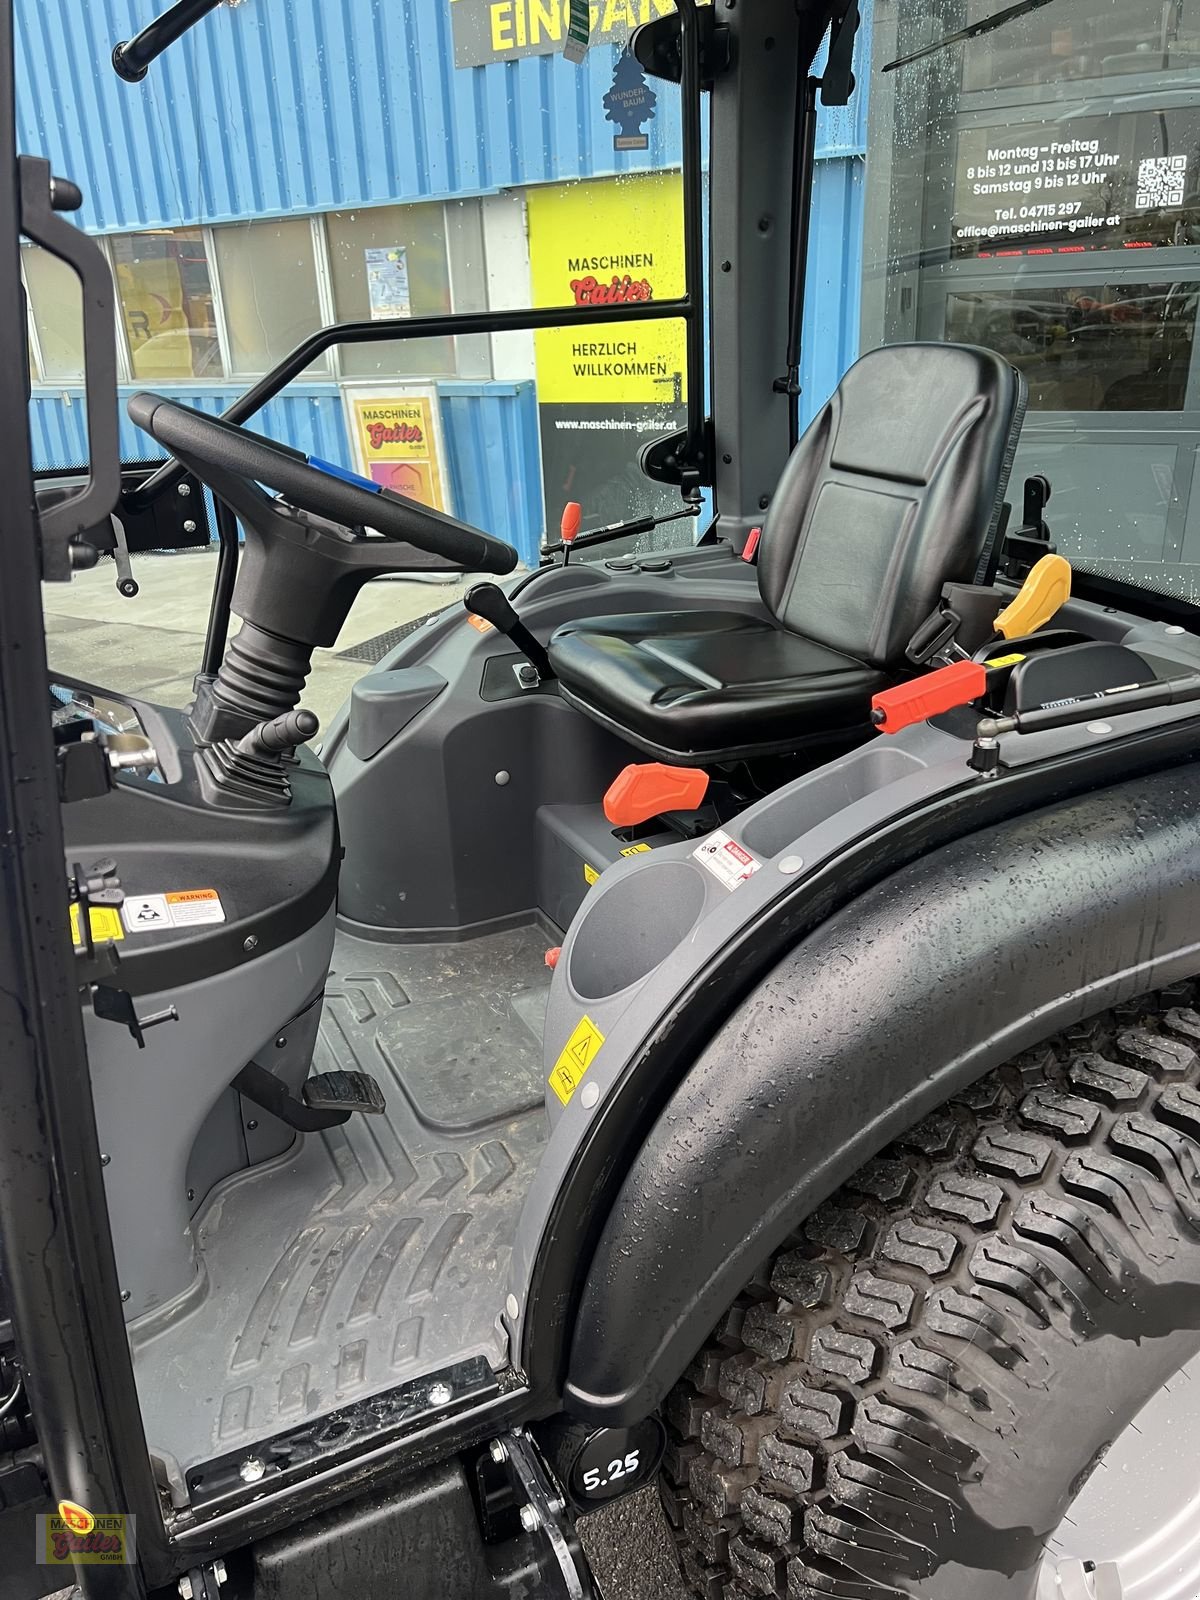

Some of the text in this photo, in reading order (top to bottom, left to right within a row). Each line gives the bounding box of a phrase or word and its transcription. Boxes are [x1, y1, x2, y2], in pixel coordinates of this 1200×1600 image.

[610, 87, 647, 102] WUNDER-
[623, 96, 646, 108] BAUM
[987, 146, 1039, 161] Montag
[1050, 139, 1099, 155] Freitag
[966, 153, 1120, 180] 8 bis 12 und 13 bis 17 Uhr
[973, 172, 1107, 195] Samstag 9 bis 12 Uhr
[994, 201, 1082, 221] Tel. 04715 297
[568, 253, 653, 272] MASCHINEN
[572, 342, 637, 357] HERZLICH
[573, 362, 667, 377] WILLKOMMEN
[362, 409, 421, 420] MASCHINEN
[555, 418, 677, 433] www.maschinen-gailer.at
[366, 422, 423, 450] Gailer
[179, 892, 213, 901] WARNING
[582, 1449, 640, 1491] 5.25
